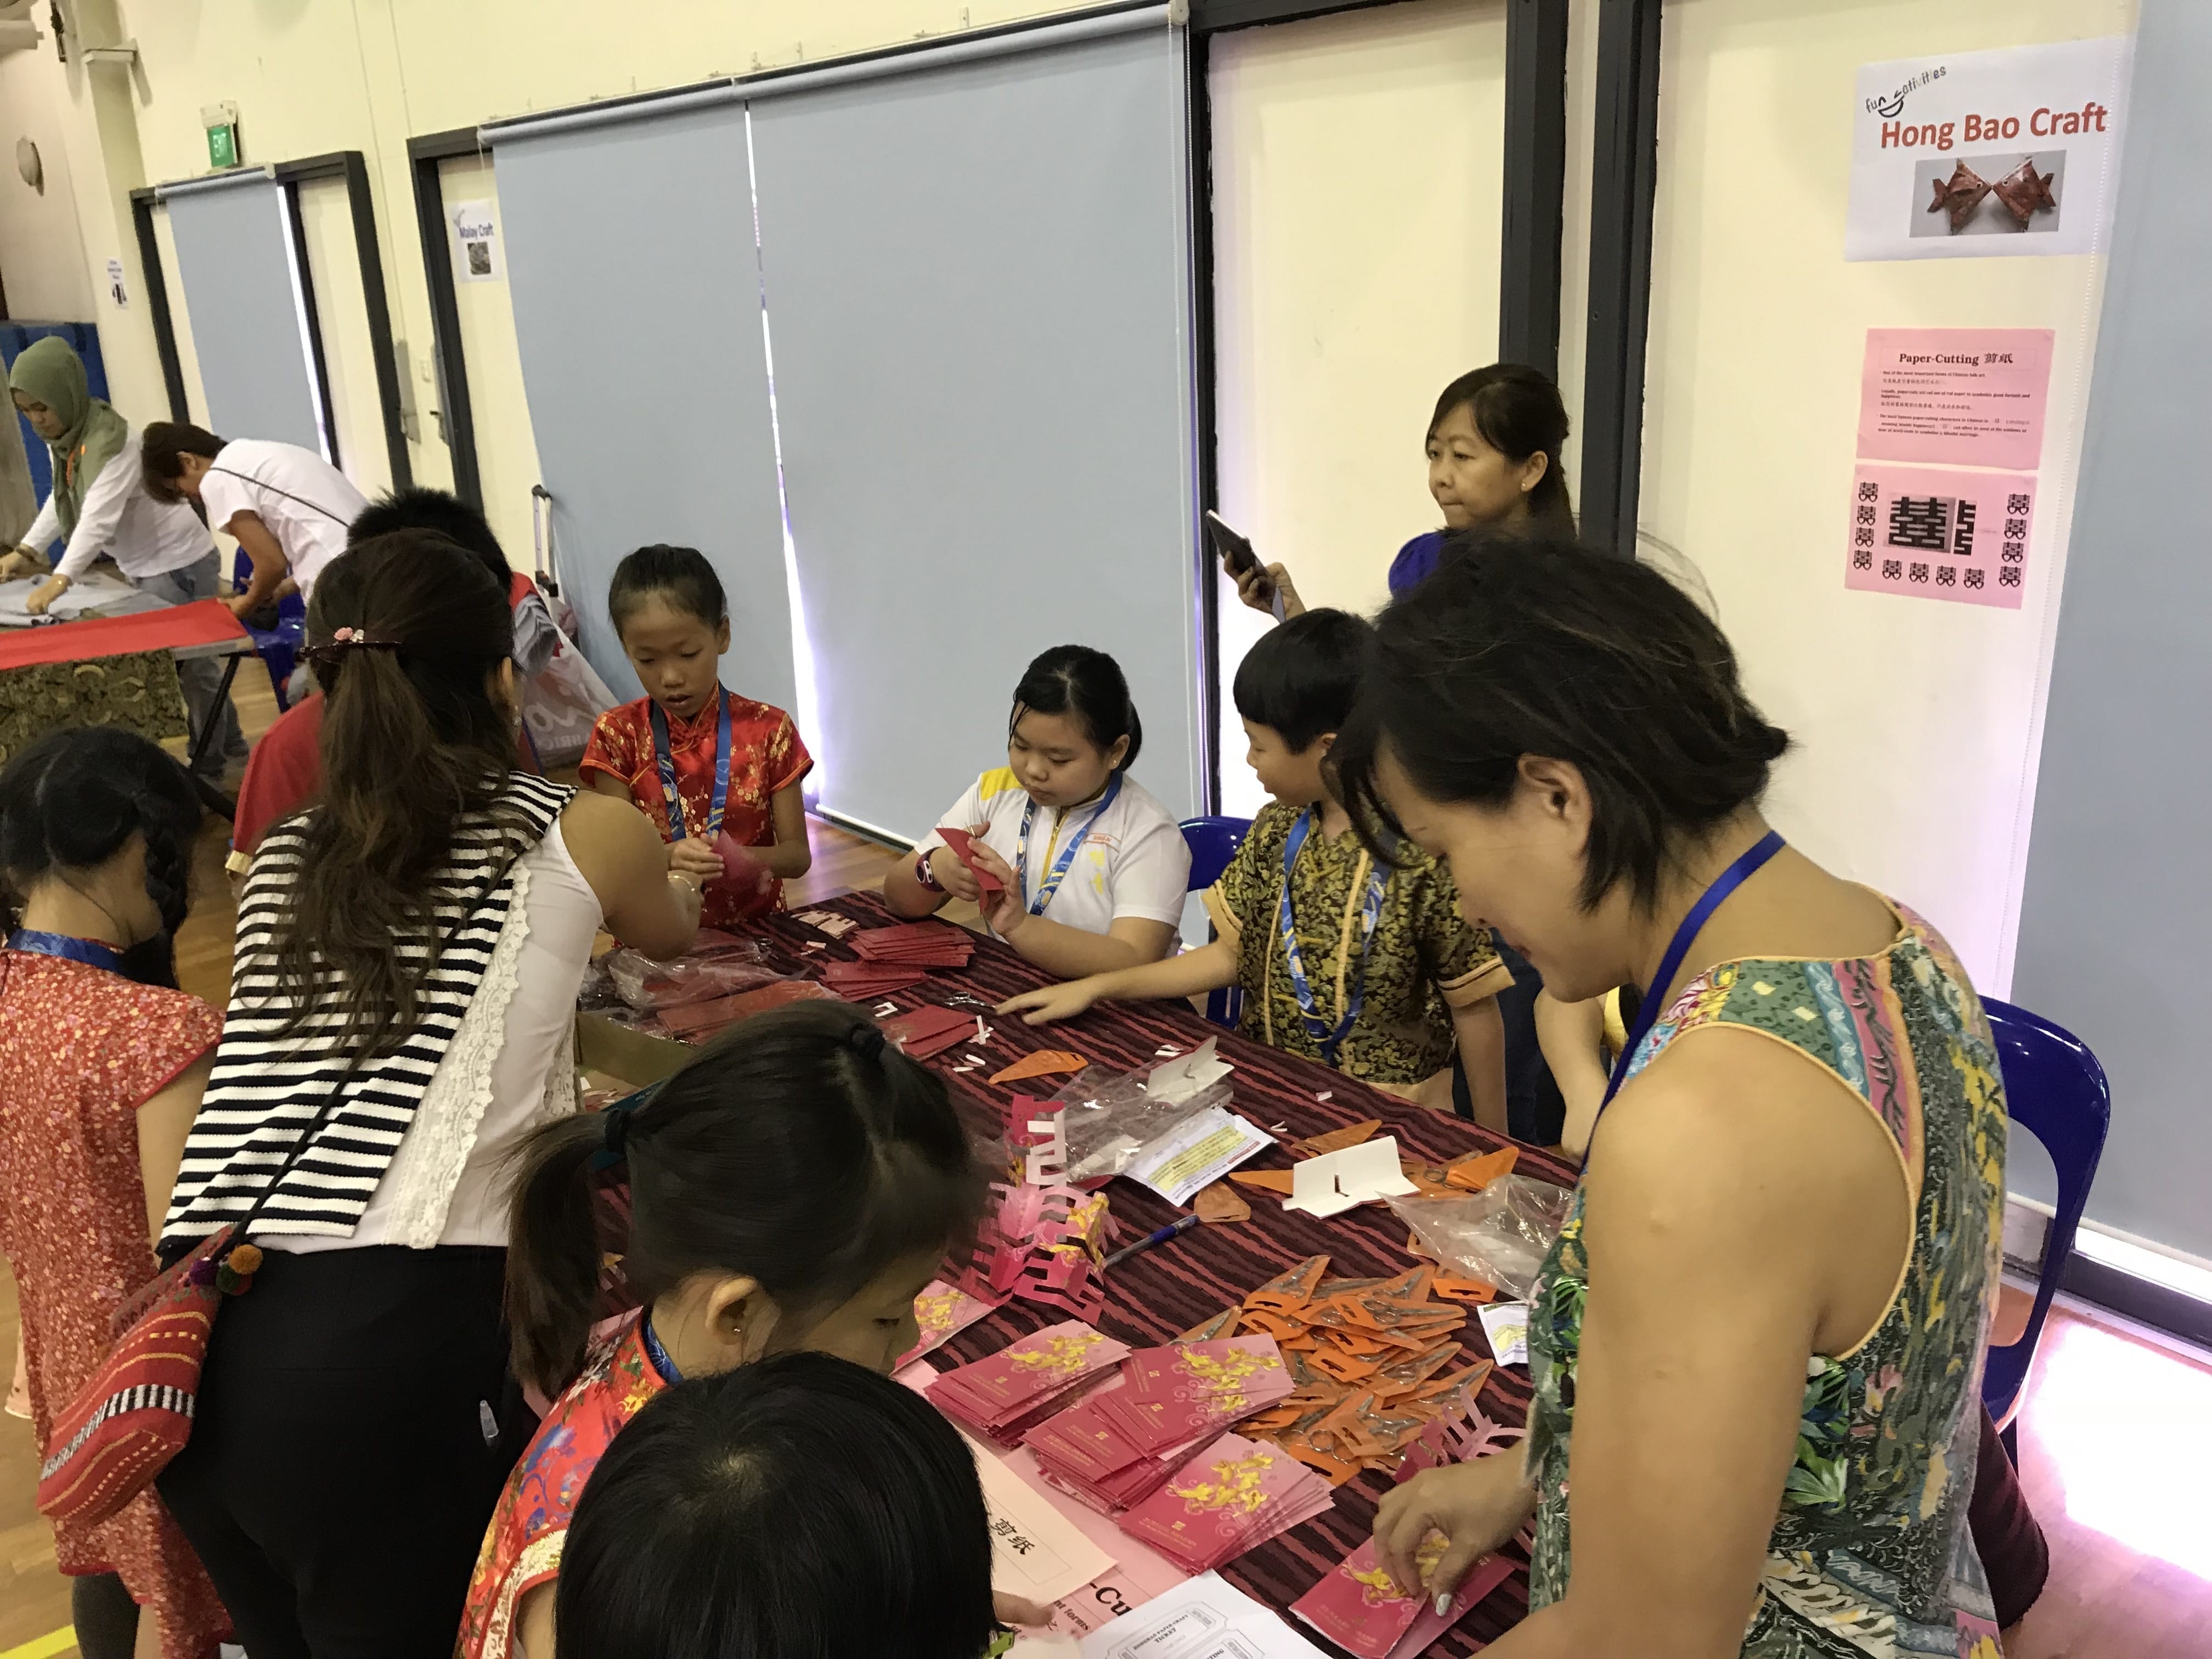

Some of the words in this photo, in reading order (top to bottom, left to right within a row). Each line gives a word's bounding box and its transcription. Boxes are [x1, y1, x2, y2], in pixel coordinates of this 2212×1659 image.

[1881, 120, 1955, 151] Hong
[1963, 114, 2019, 143] Bao
[2030, 101, 2107, 137] Craft
[1899, 353, 1979, 366] Paper-Cutting
[1984, 352, 2013, 364] 剪纸
[992, 1518, 1035, 1555] 剪纸
[1089, 1582, 1133, 1616] -Cu
[1064, 1608, 1090, 1631] forms
[1154, 1627, 1177, 1643] TICKET
